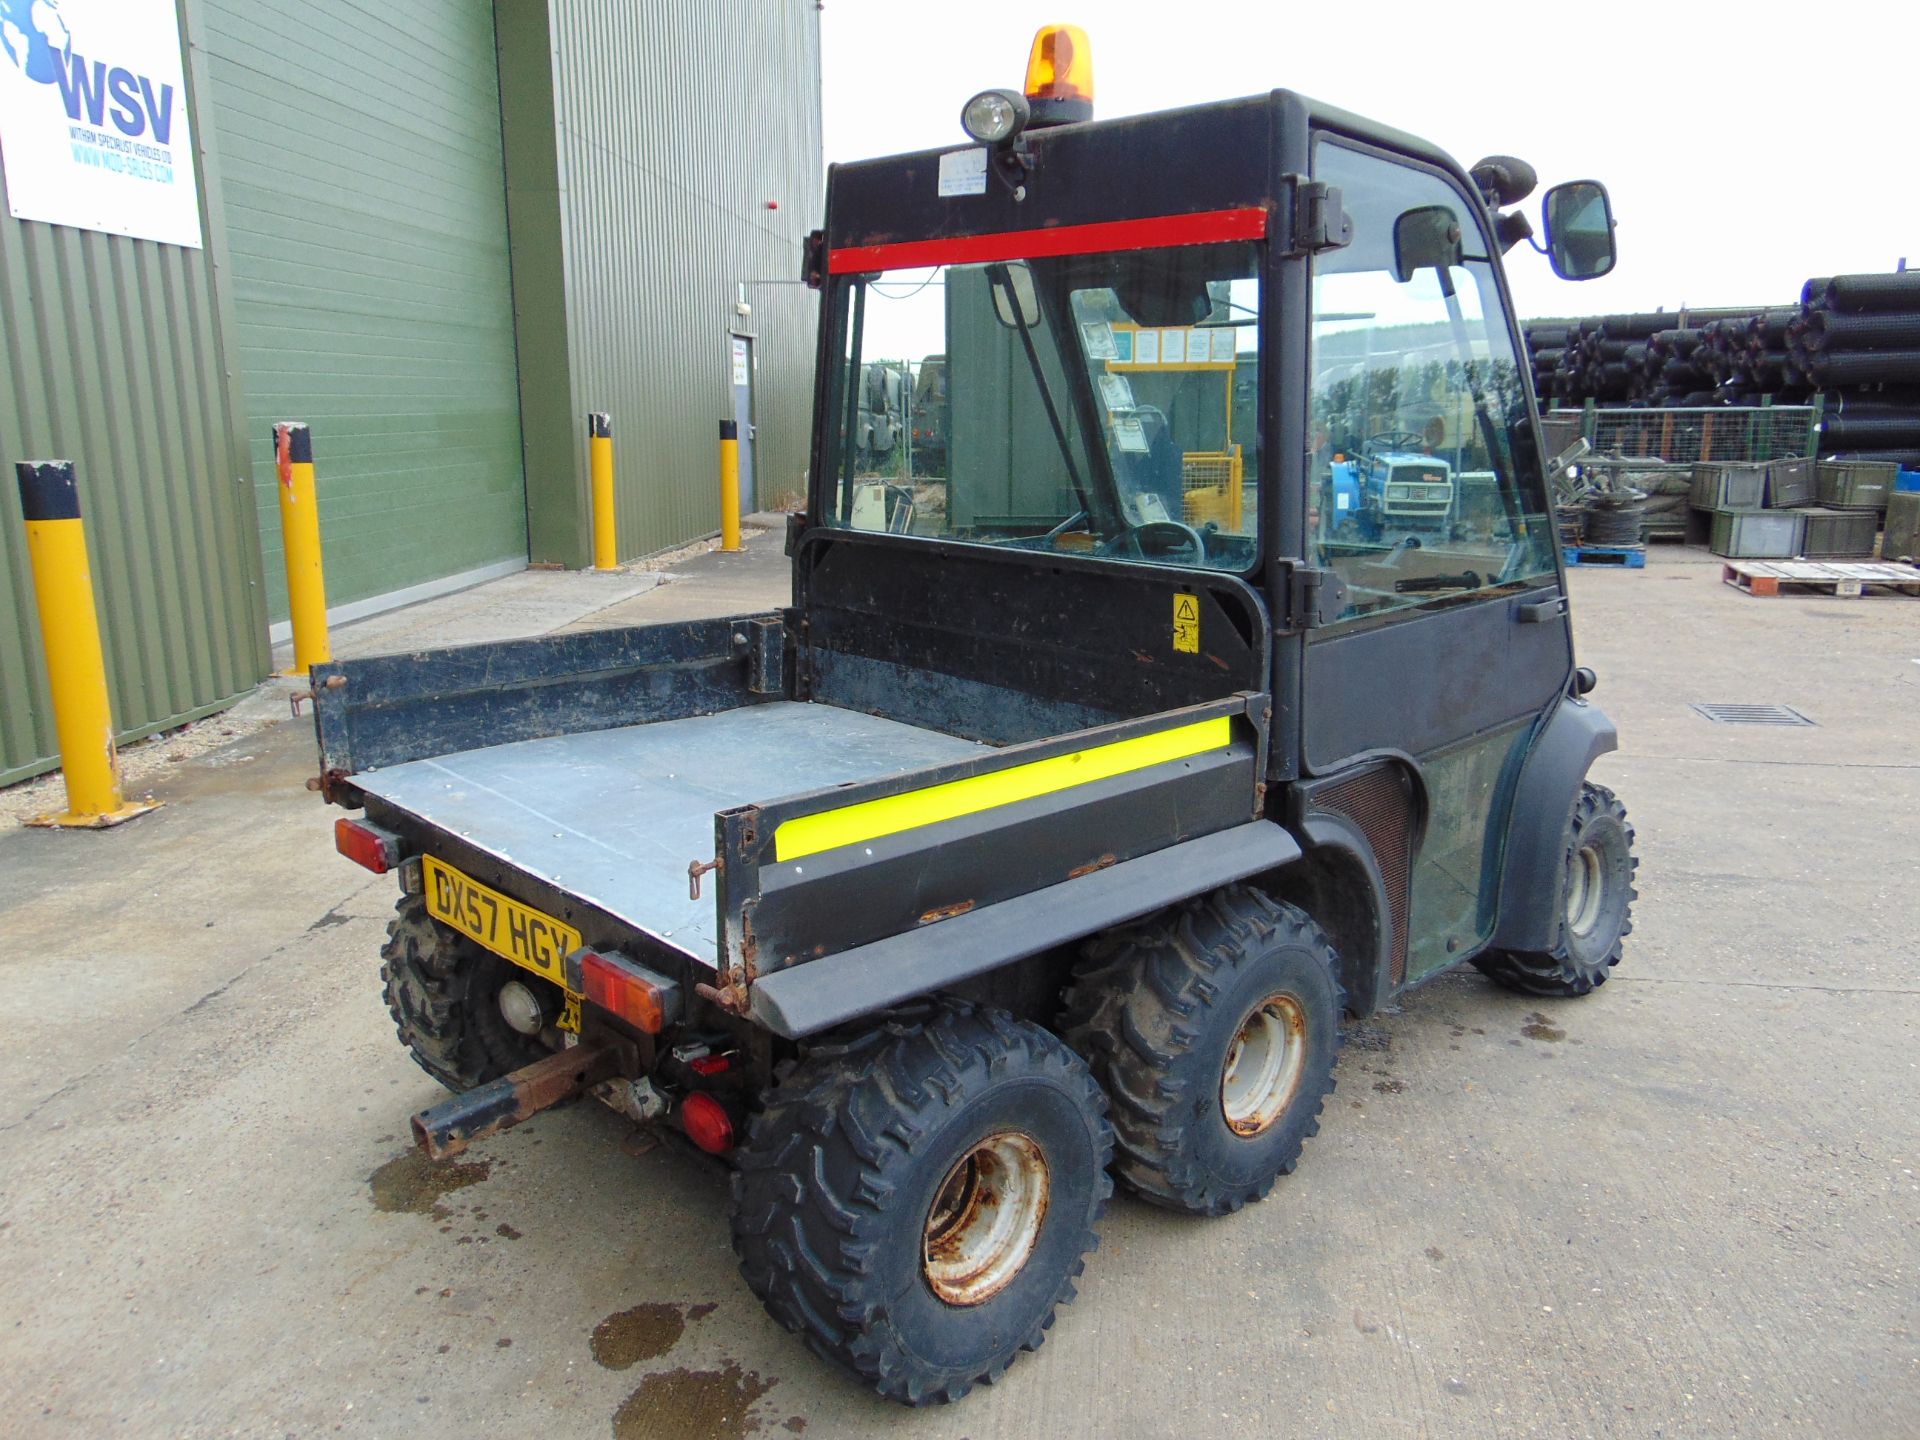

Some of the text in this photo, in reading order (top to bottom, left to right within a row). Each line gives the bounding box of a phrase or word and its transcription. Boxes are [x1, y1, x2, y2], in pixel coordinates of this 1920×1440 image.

[49, 46, 173, 144] WSV
[70, 127, 96, 142] WITHAM
[98, 134, 132, 153] SPECIALIST
[133, 144, 161, 161] VEHICLES
[434, 868, 568, 978] DX57 HGY
